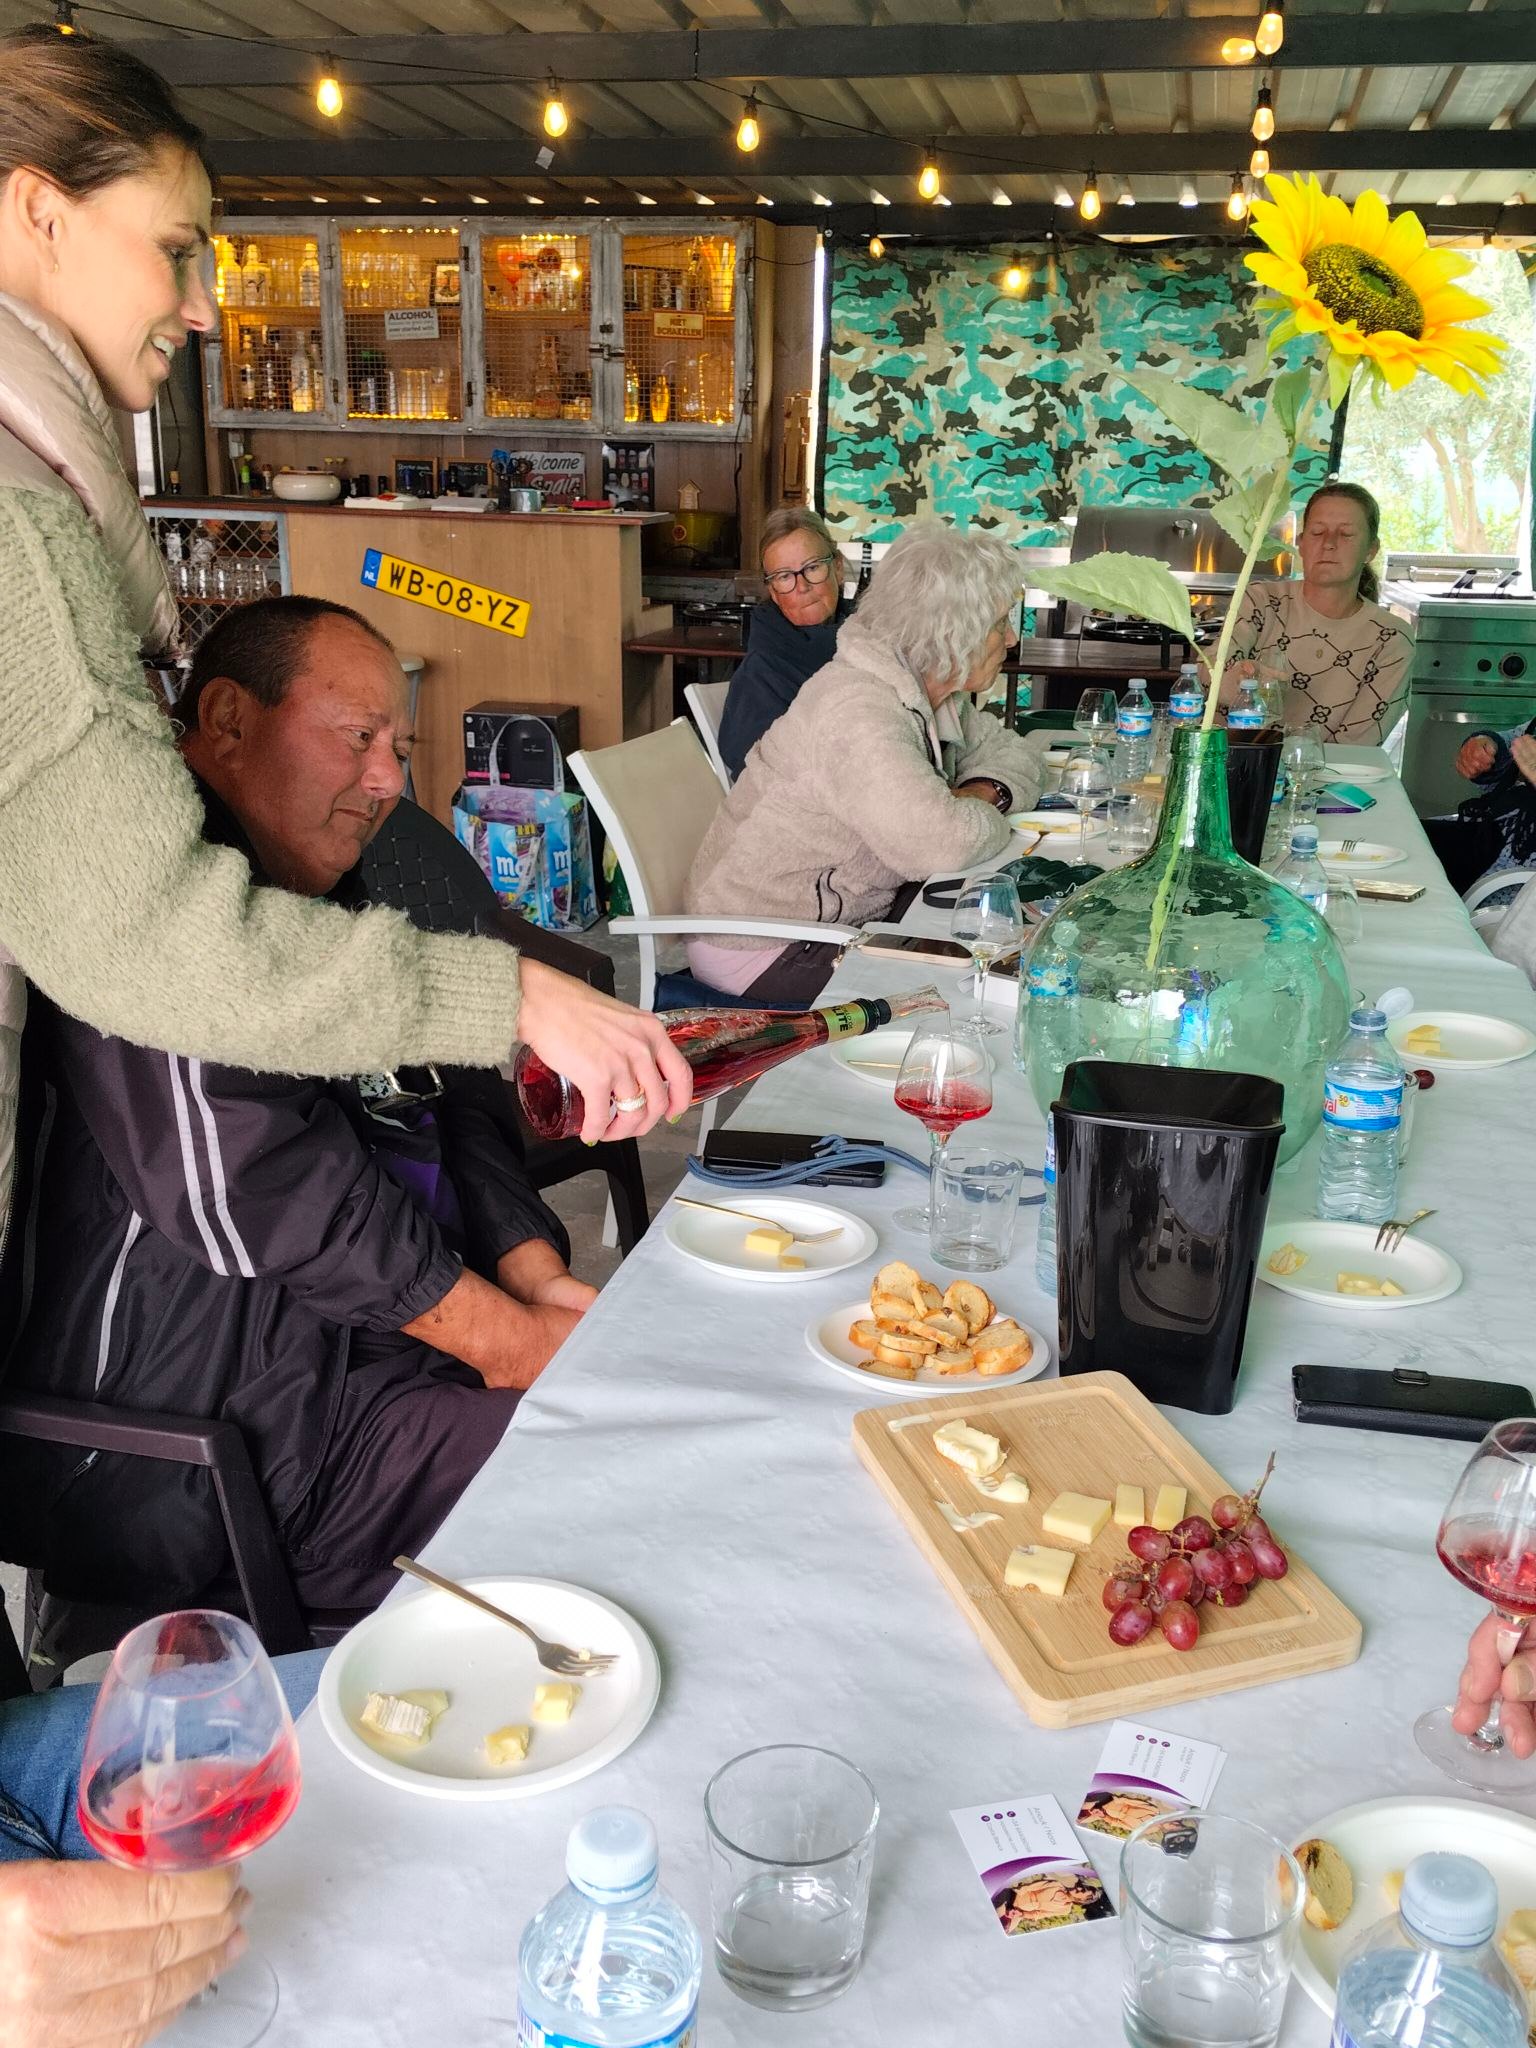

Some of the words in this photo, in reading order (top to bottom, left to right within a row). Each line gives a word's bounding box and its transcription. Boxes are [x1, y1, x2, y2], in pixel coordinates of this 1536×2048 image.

[389, 311, 434, 320] ALCOHOL
[364, 570, 376, 581] NL
[389, 562, 520, 630] WB-08-YZ
